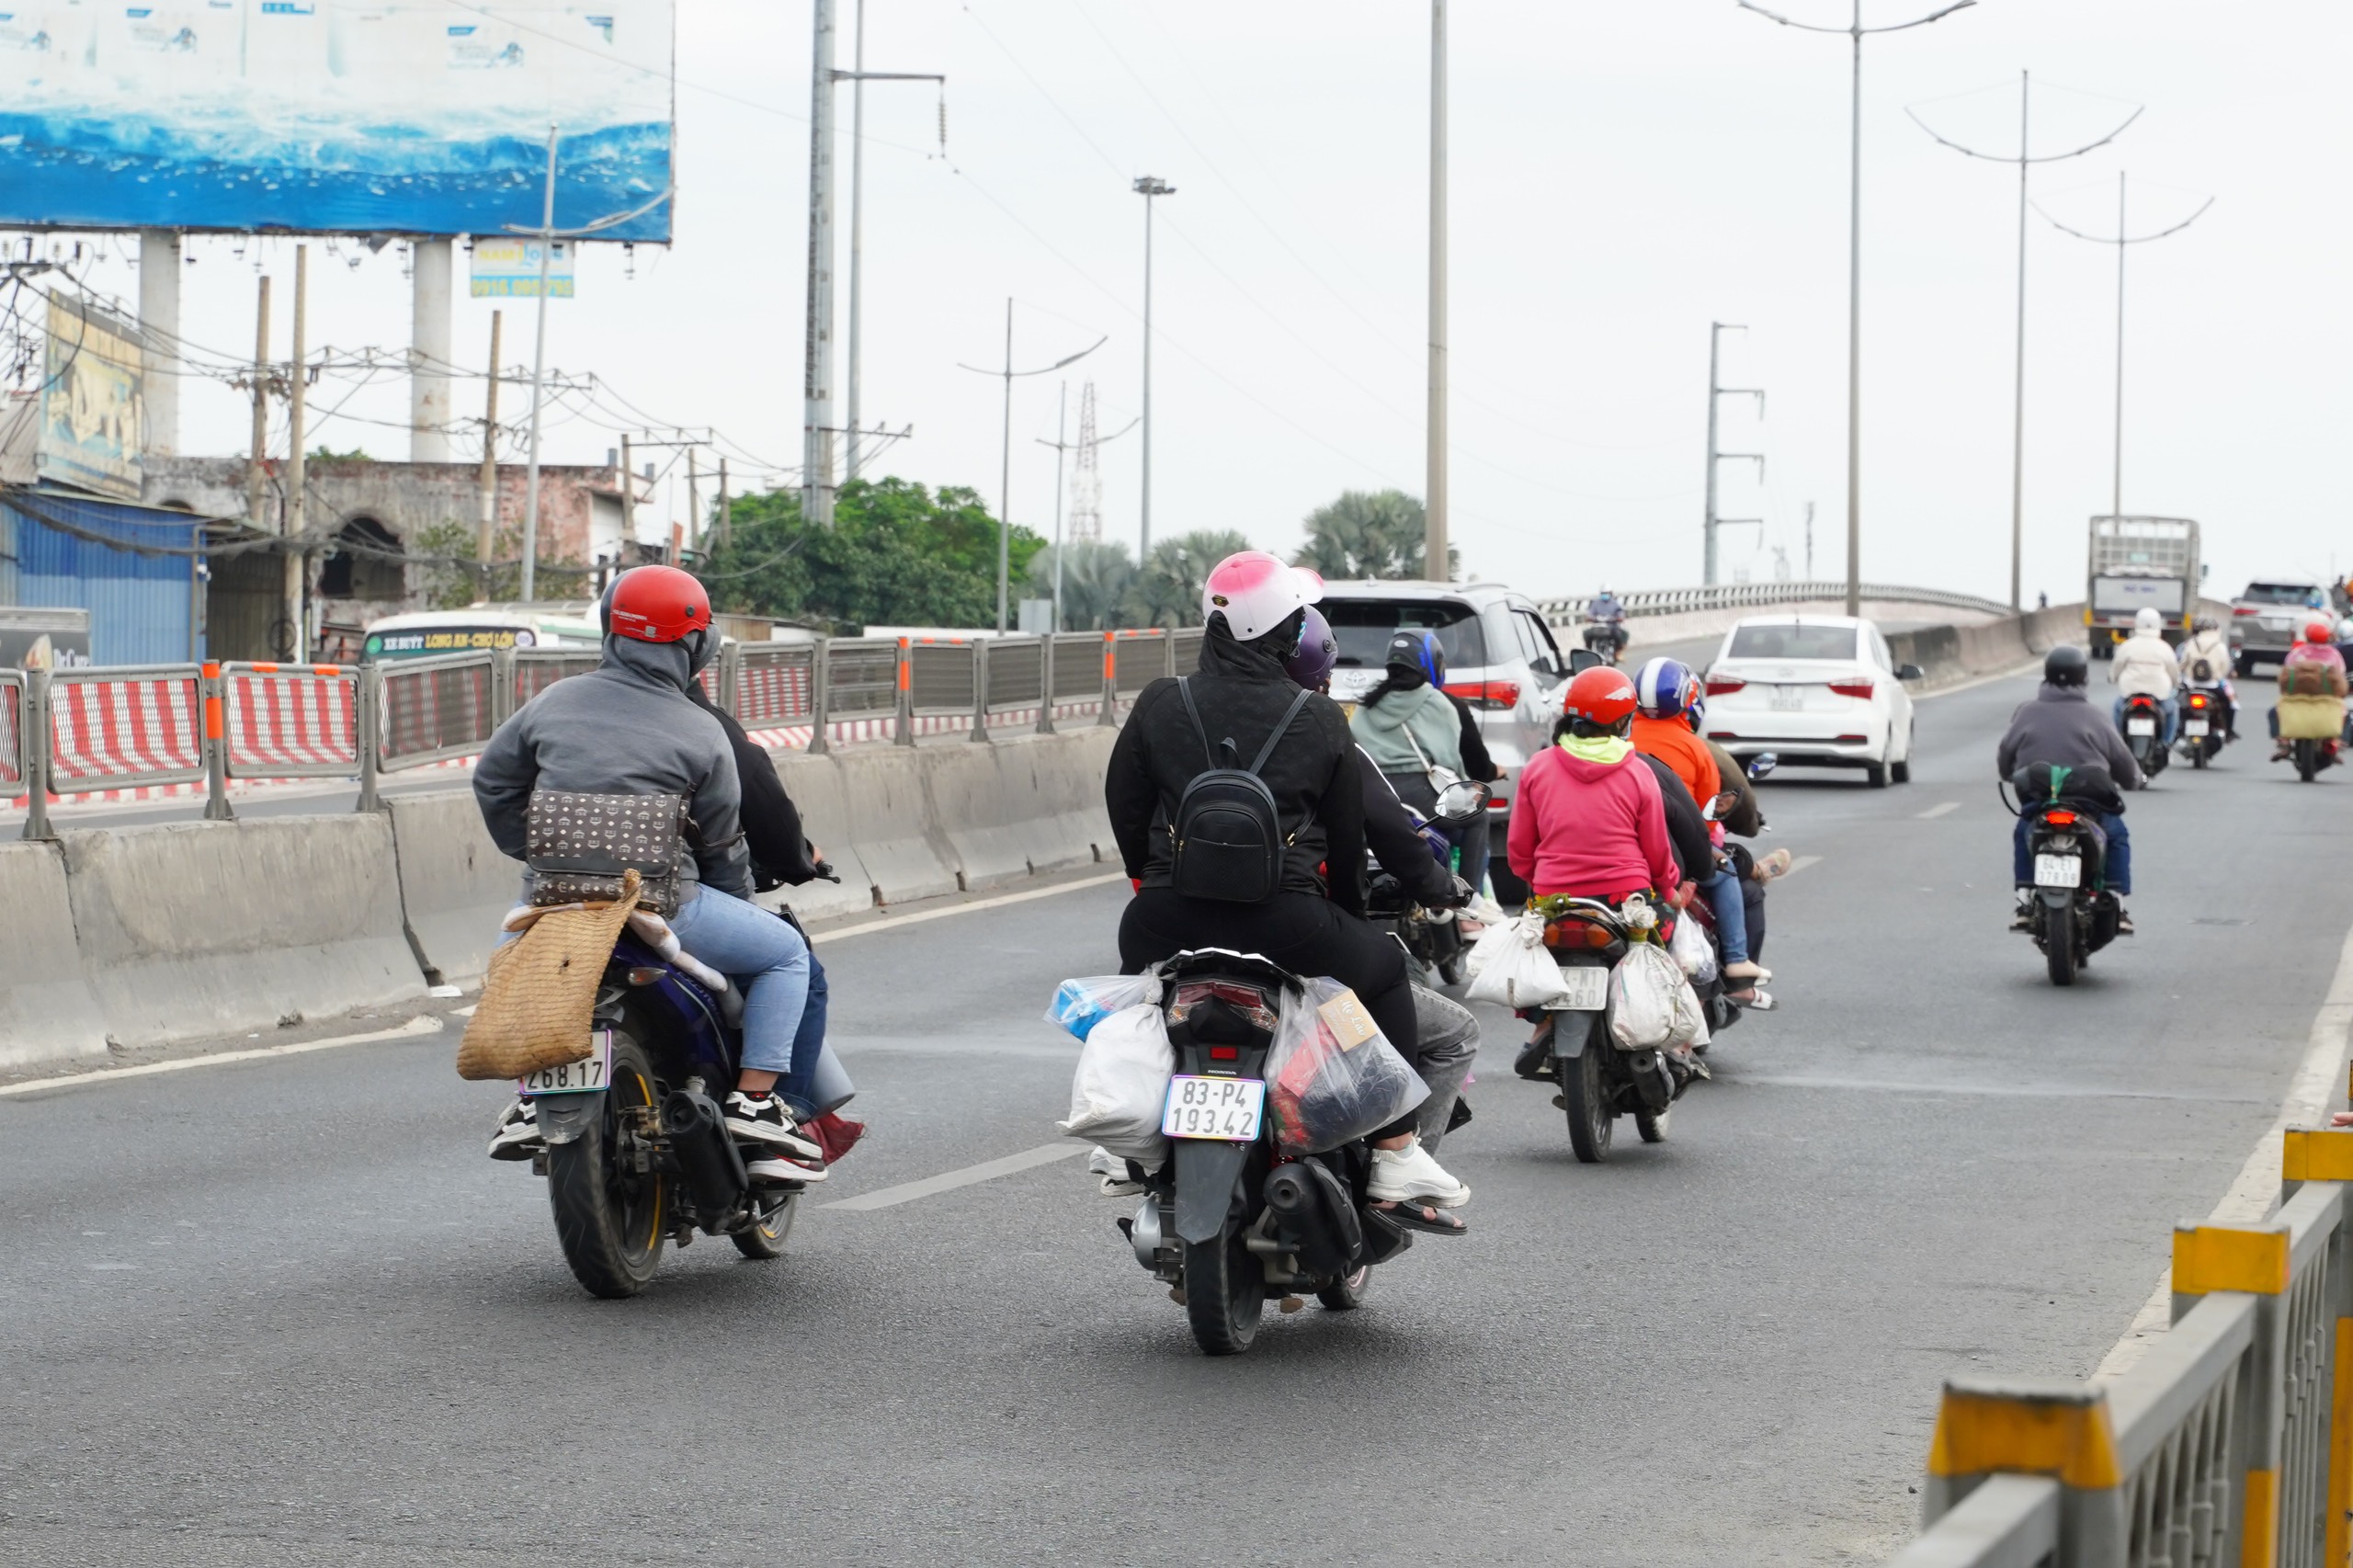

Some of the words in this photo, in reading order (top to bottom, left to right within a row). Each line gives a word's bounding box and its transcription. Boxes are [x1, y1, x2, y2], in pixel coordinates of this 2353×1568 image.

[383, 637, 398, 651] XE
[425, 633, 452, 648] LONG
[528, 1061, 603, 1089] 268.17
[1183, 1081, 1246, 1108] 83-P4
[1174, 1108, 1254, 1136] 193.42
